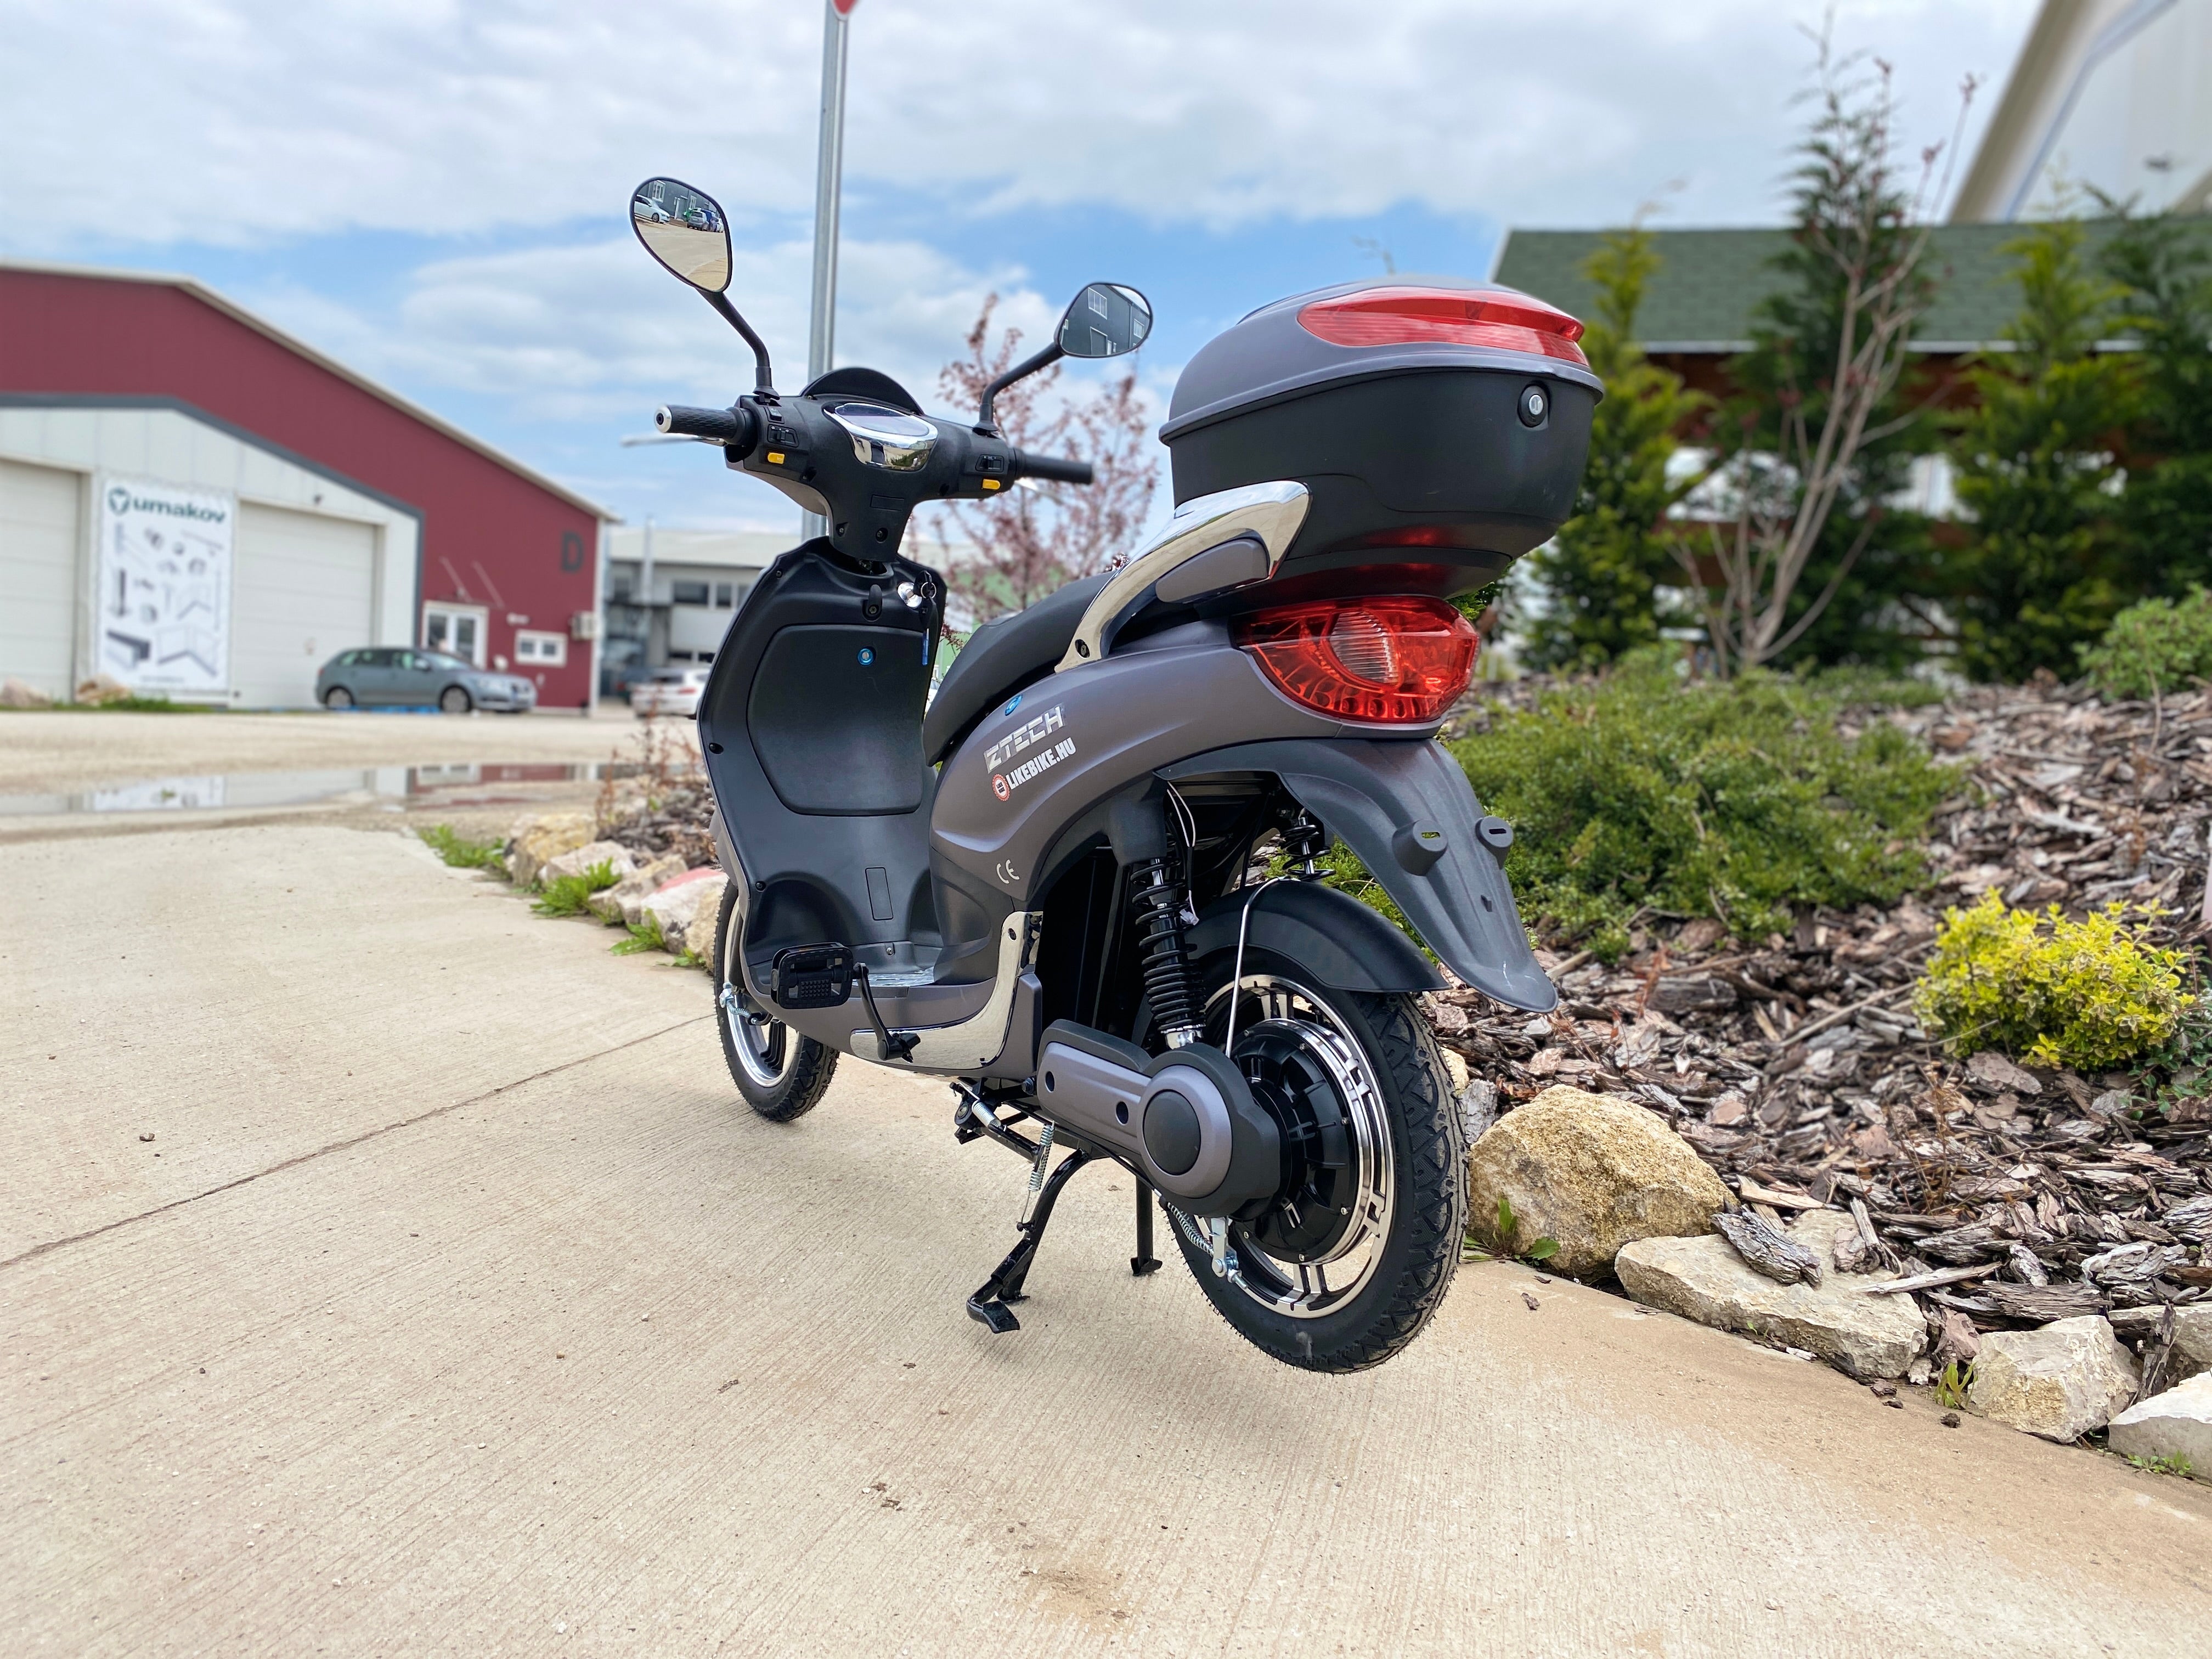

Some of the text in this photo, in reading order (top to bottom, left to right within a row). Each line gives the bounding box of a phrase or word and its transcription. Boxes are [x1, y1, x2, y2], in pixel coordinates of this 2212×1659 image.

[133, 497, 225, 523] umakov
[561, 531, 584, 572] D
[986, 706, 1063, 771] ZTECH
[1005, 737, 1076, 790] LIKEBIKE.HU
[996, 859, 1020, 884] CE
